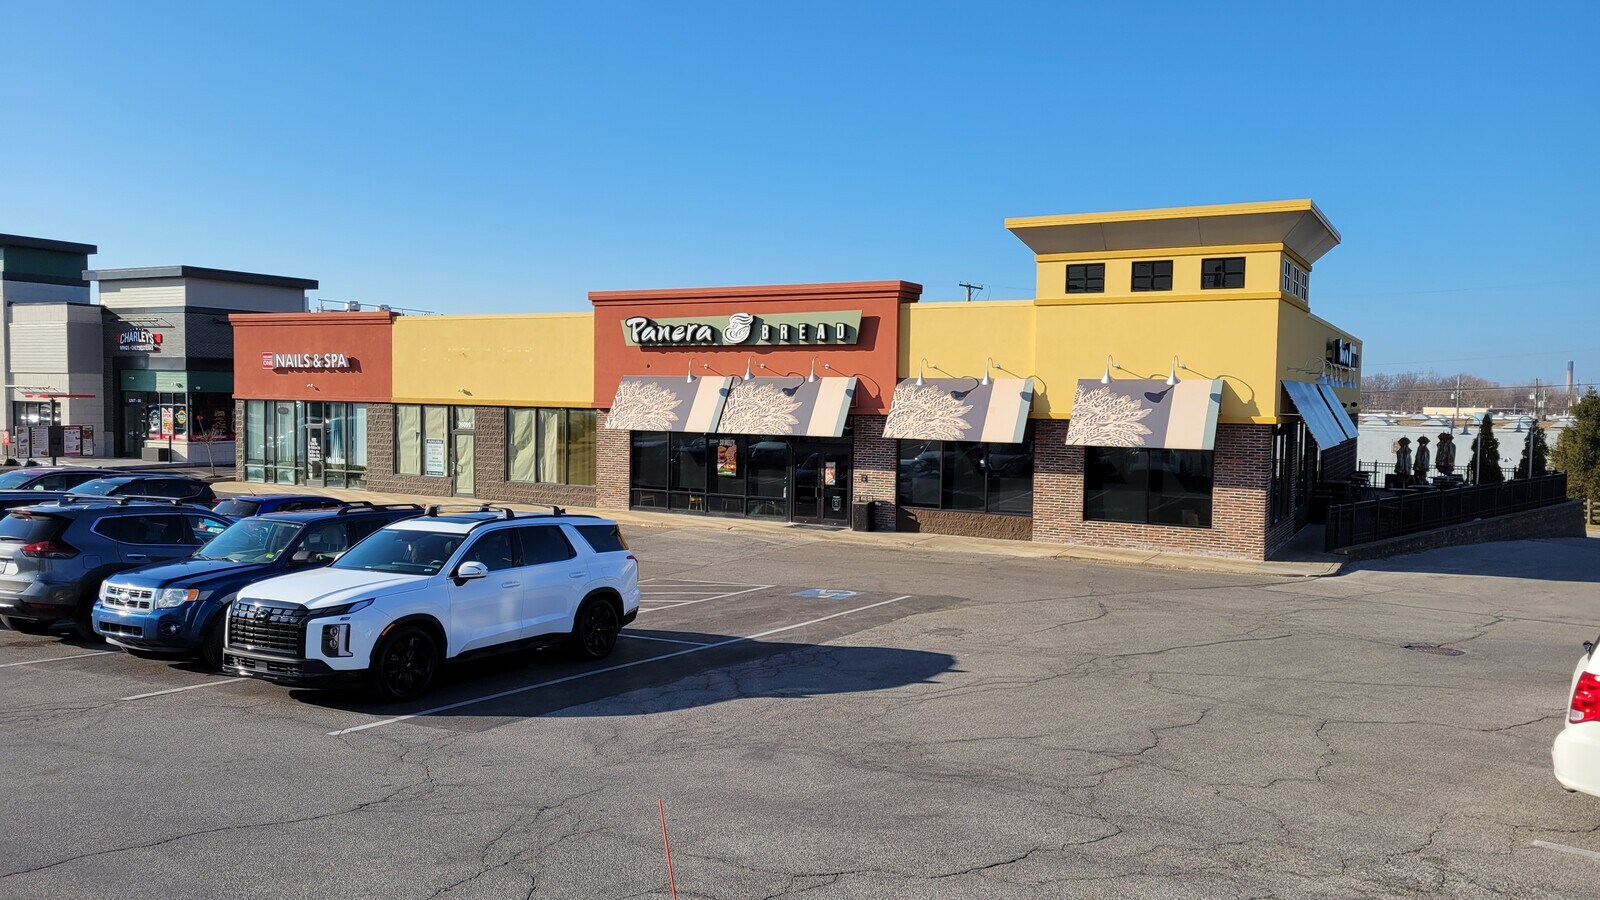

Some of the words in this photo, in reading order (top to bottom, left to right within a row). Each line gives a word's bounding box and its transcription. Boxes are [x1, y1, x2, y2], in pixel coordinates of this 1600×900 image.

[120, 331, 154, 344] CHARLEYS
[625, 316, 713, 344] Panera
[760, 322, 846, 341] BREAD
[276, 353, 310, 368] NAILS
[313, 353, 322, 368] &
[324, 353, 347, 368] SPA
